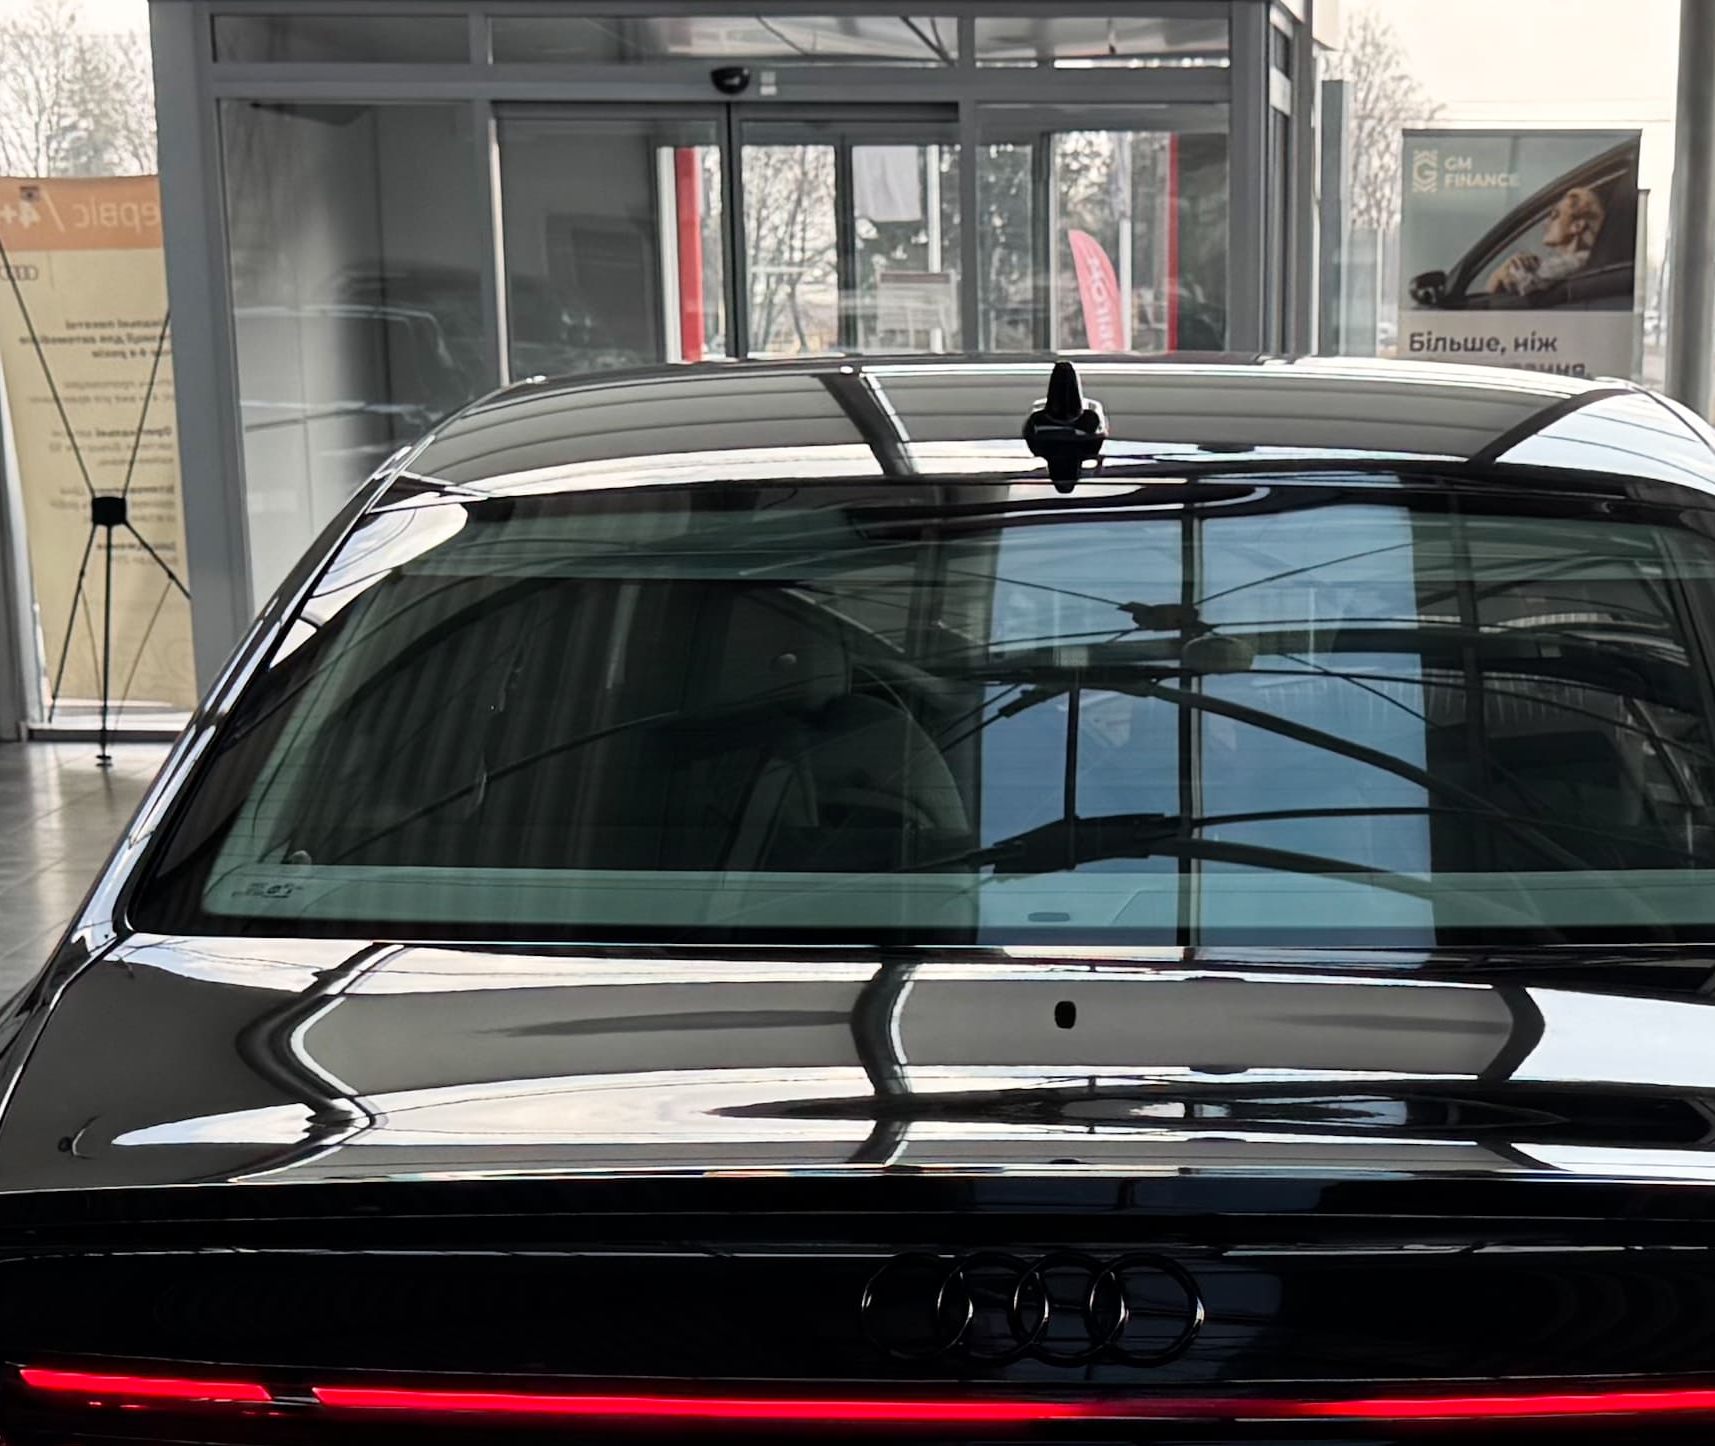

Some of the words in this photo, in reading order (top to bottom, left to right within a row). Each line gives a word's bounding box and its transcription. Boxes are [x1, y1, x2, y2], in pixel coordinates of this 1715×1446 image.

[1444, 156, 1473, 171] GM
[1444, 172, 1519, 188] FINANCE
[1409, 331, 1506, 356] Більше,
[1514, 331, 1558, 352] ніж
